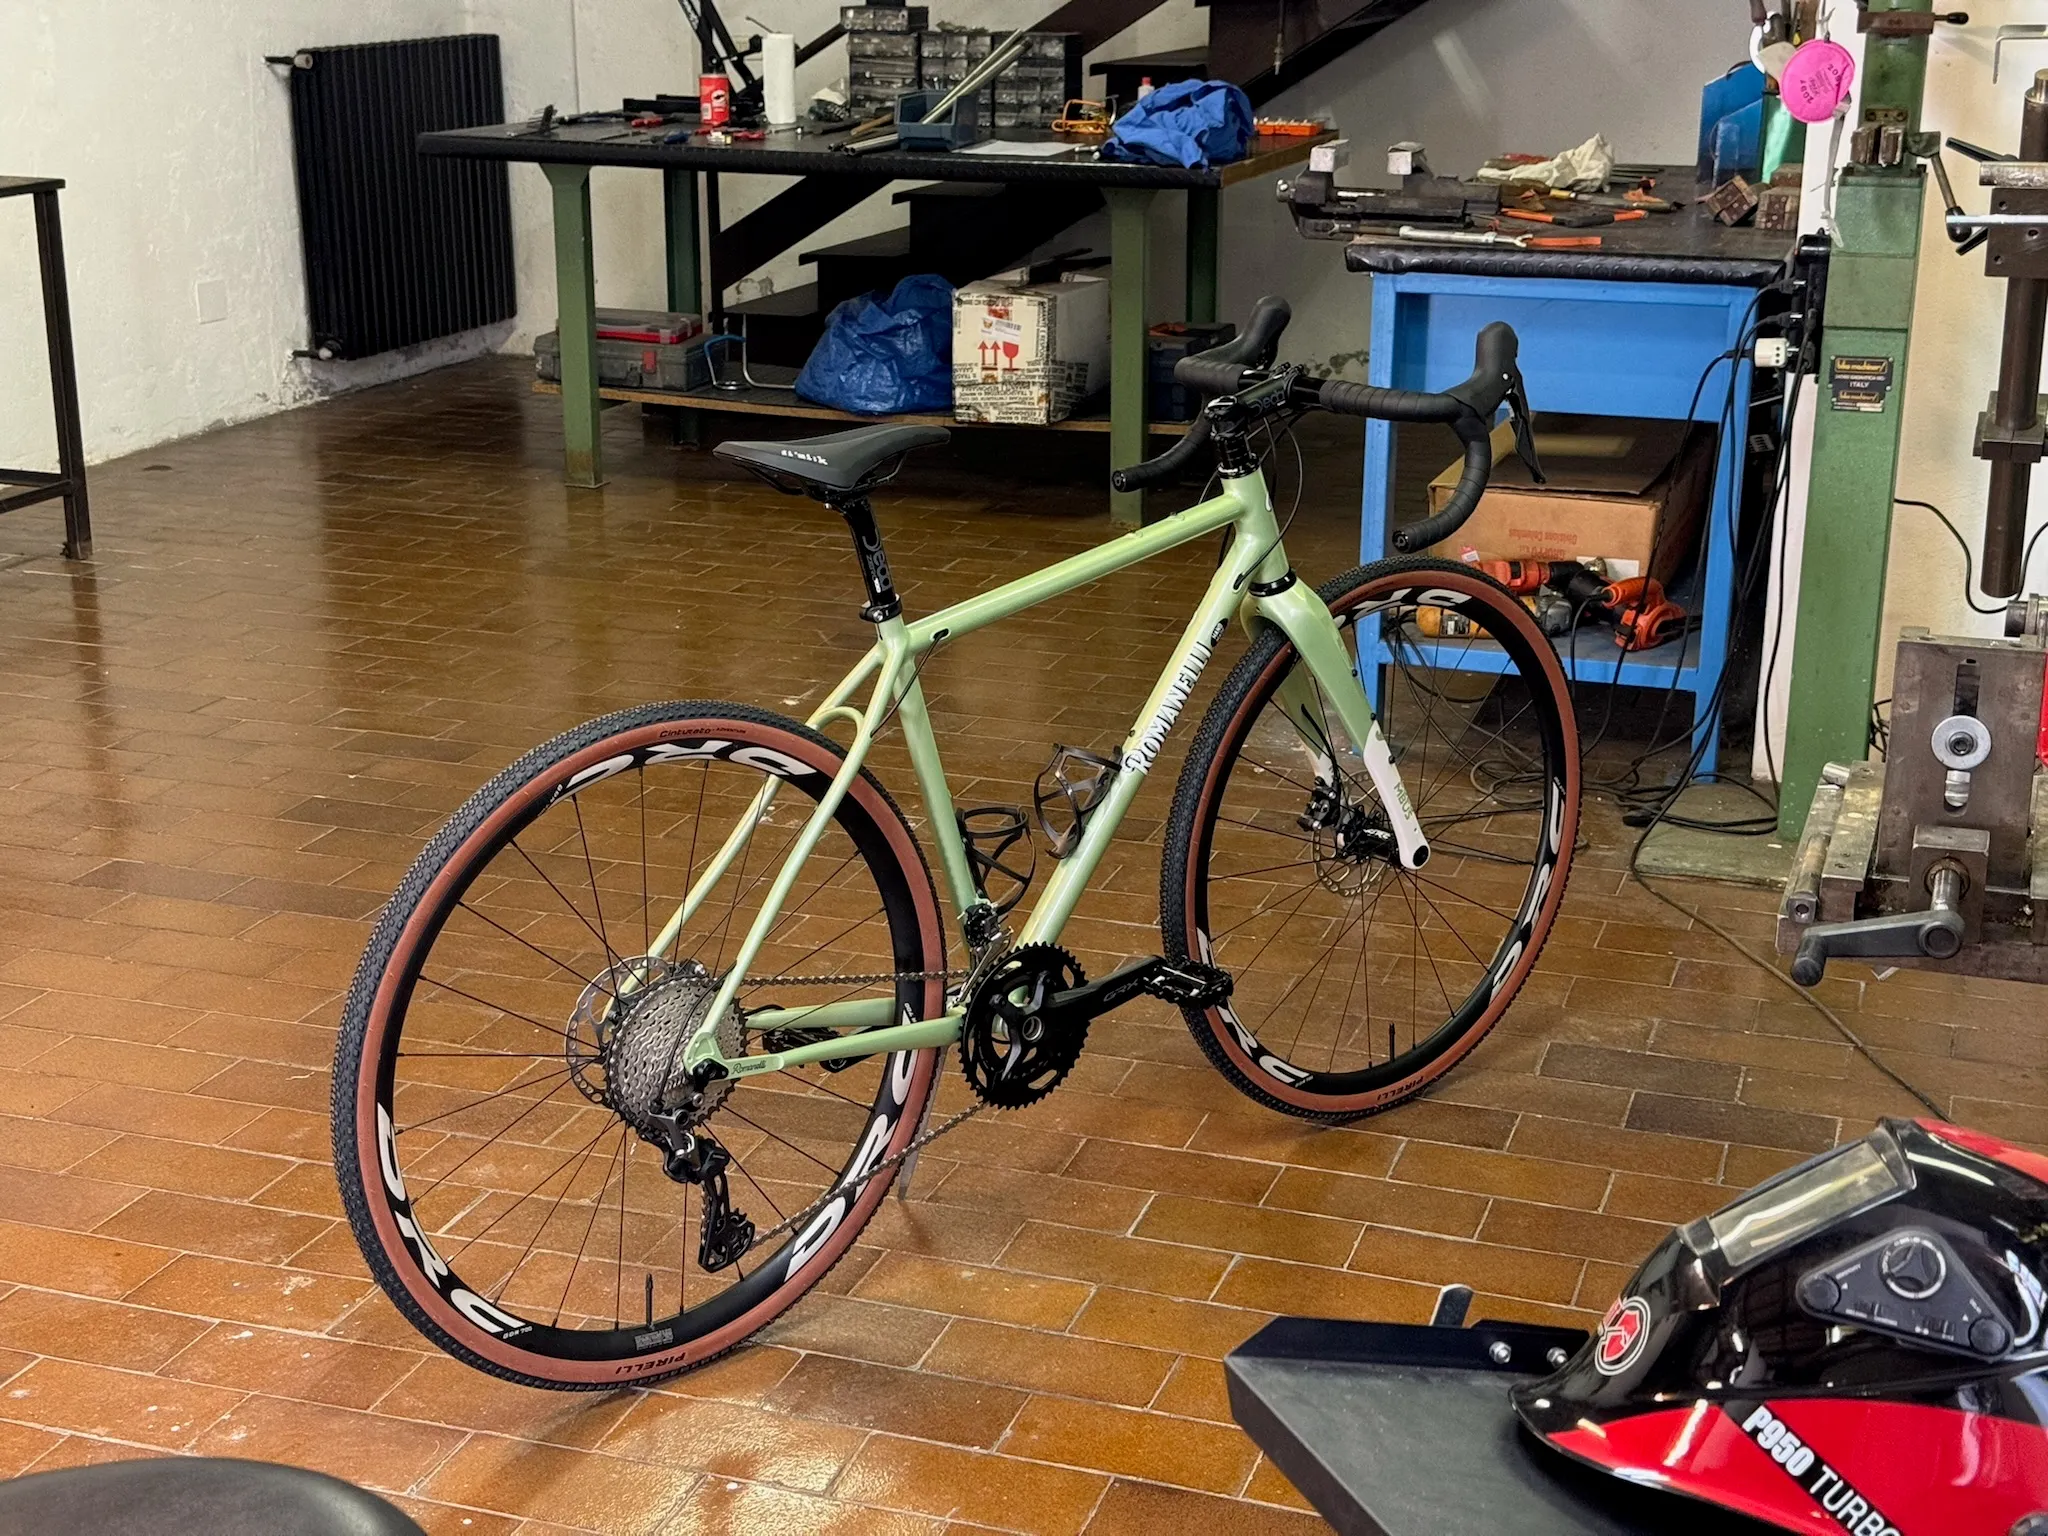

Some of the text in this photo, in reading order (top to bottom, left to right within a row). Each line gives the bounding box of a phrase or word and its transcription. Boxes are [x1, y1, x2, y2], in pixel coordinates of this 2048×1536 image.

[1121, 641, 1214, 774] ROMANELLI
[659, 727, 711, 738] Cinturato
[1103, 978, 1139, 1002] GRX
[731, 1060, 766, 1075] Romanelli
[1377, 1076, 1424, 1101] PIRELLI
[615, 1351, 686, 1375] PIRELLI
[1741, 1405, 1815, 1477] P950
